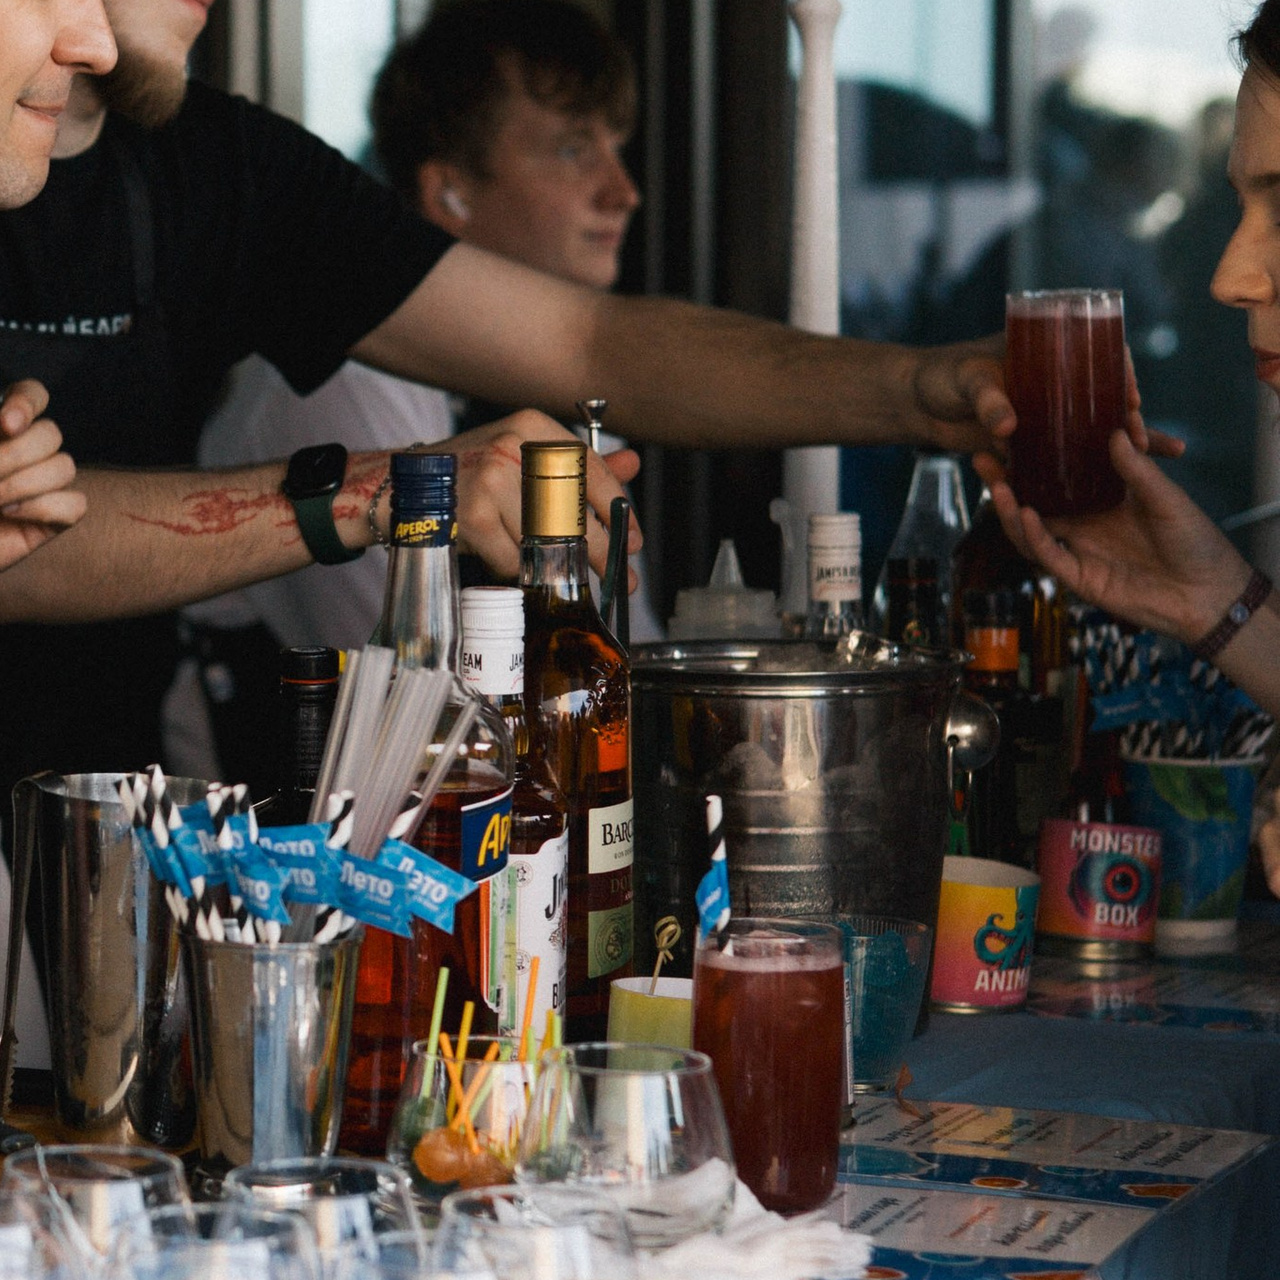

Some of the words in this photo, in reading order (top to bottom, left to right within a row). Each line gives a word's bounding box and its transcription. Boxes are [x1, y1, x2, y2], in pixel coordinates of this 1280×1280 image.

[395, 518, 440, 539] APEROL
[463, 652, 483, 672] EAM
[340, 860, 396, 900] Лето
[1094, 902, 1139, 928] BOX
